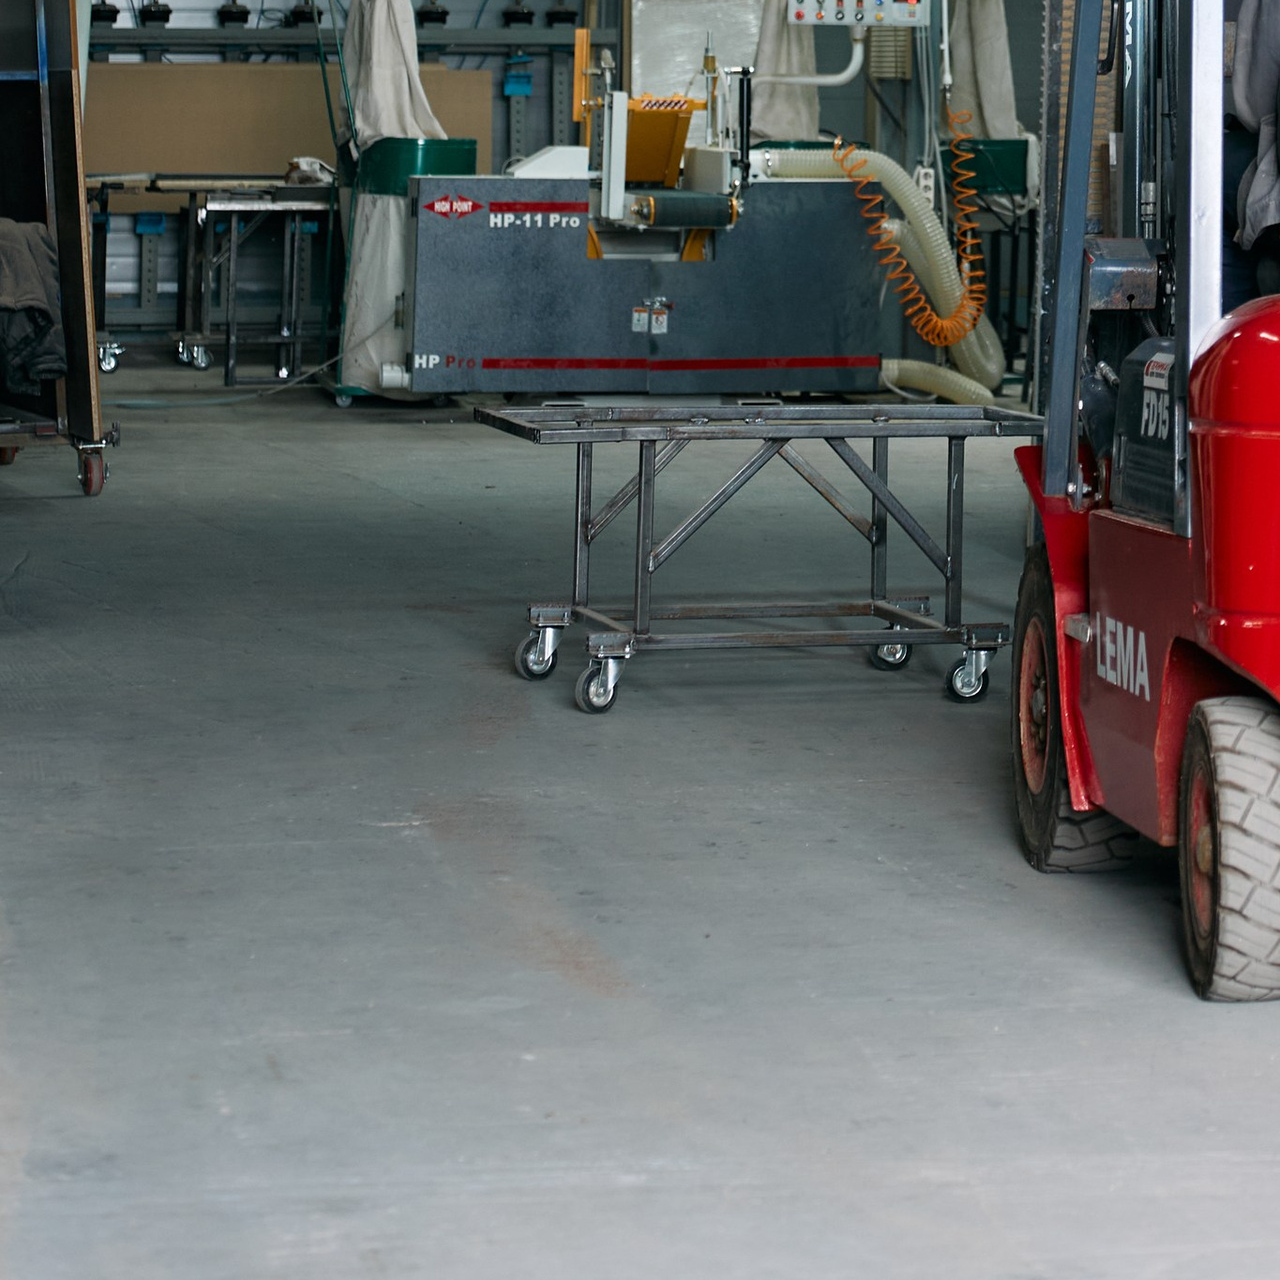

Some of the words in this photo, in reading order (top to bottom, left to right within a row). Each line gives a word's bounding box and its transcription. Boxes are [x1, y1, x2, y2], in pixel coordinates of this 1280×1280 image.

[434, 200, 451, 213] HIGH
[452, 200, 473, 213] POINT
[489, 213, 543, 228] HP-11
[549, 213, 580, 228] Pro
[414, 354, 441, 369] HP
[445, 354, 477, 369] Pro
[1140, 389, 1170, 440] FD15
[1096, 611, 1151, 702] LEMA
